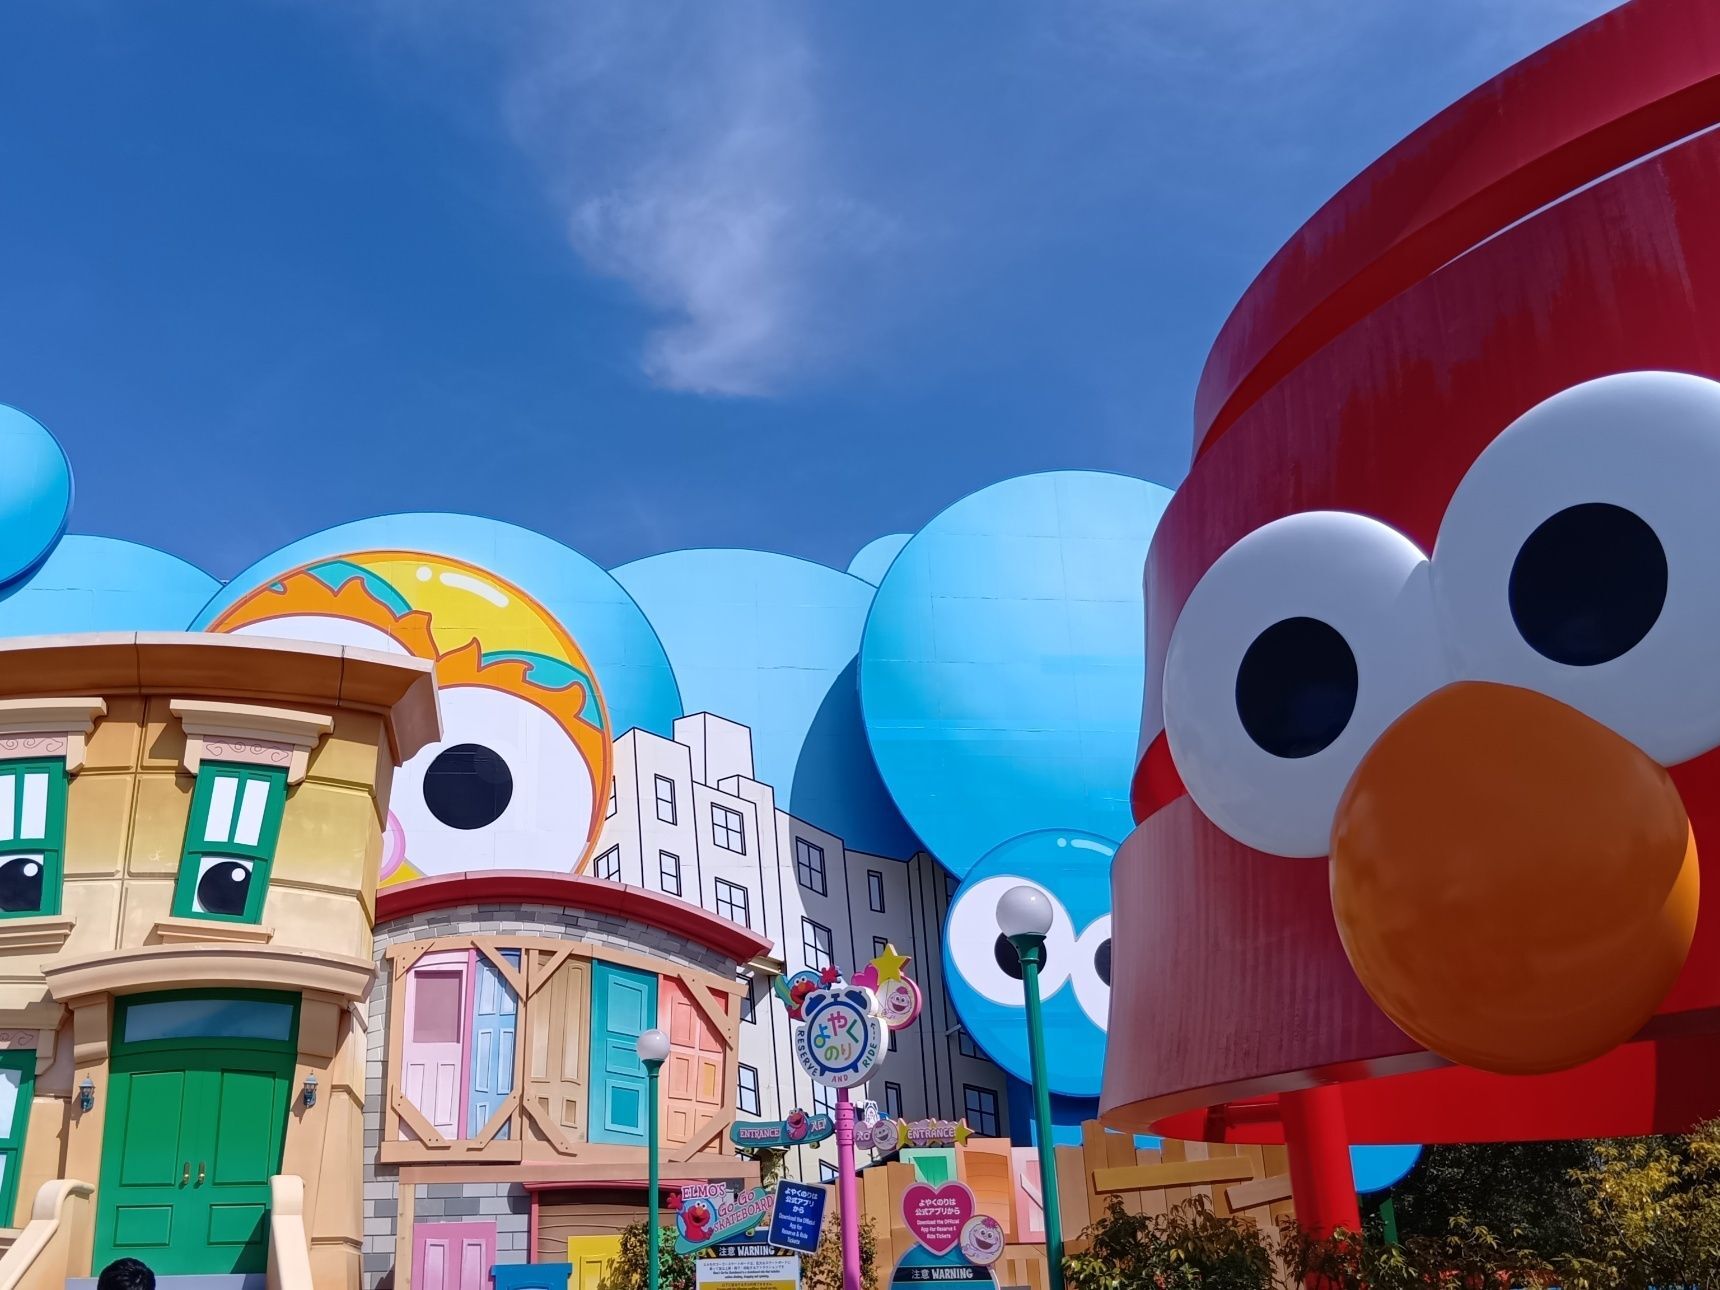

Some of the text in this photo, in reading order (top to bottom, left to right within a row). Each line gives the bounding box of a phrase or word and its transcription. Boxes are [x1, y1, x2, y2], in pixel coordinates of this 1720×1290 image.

[814, 1011, 859, 1049] よやく
[797, 1030, 877, 1083] RESERVE AND RIDE
[824, 1043, 852, 1062] のり
[811, 1119, 826, 1132] 入口
[740, 1128, 780, 1139] ENTRANCE
[907, 1128, 954, 1139] ENTRANCE
[682, 1183, 725, 1200] ELMO'S
[785, 1187, 818, 1199] よやくのりは
[786, 1196, 815, 1207] 公式アプリ
[919, 1198, 956, 1206] よやくのりは
[714, 1194, 774, 1231] SKATEBOARD
[915, 1207, 960, 1215] 公式アプリから
[719, 1245, 775, 1256] 注意 WARNING
[911, 1268, 973, 1279] 注意 WARNING
